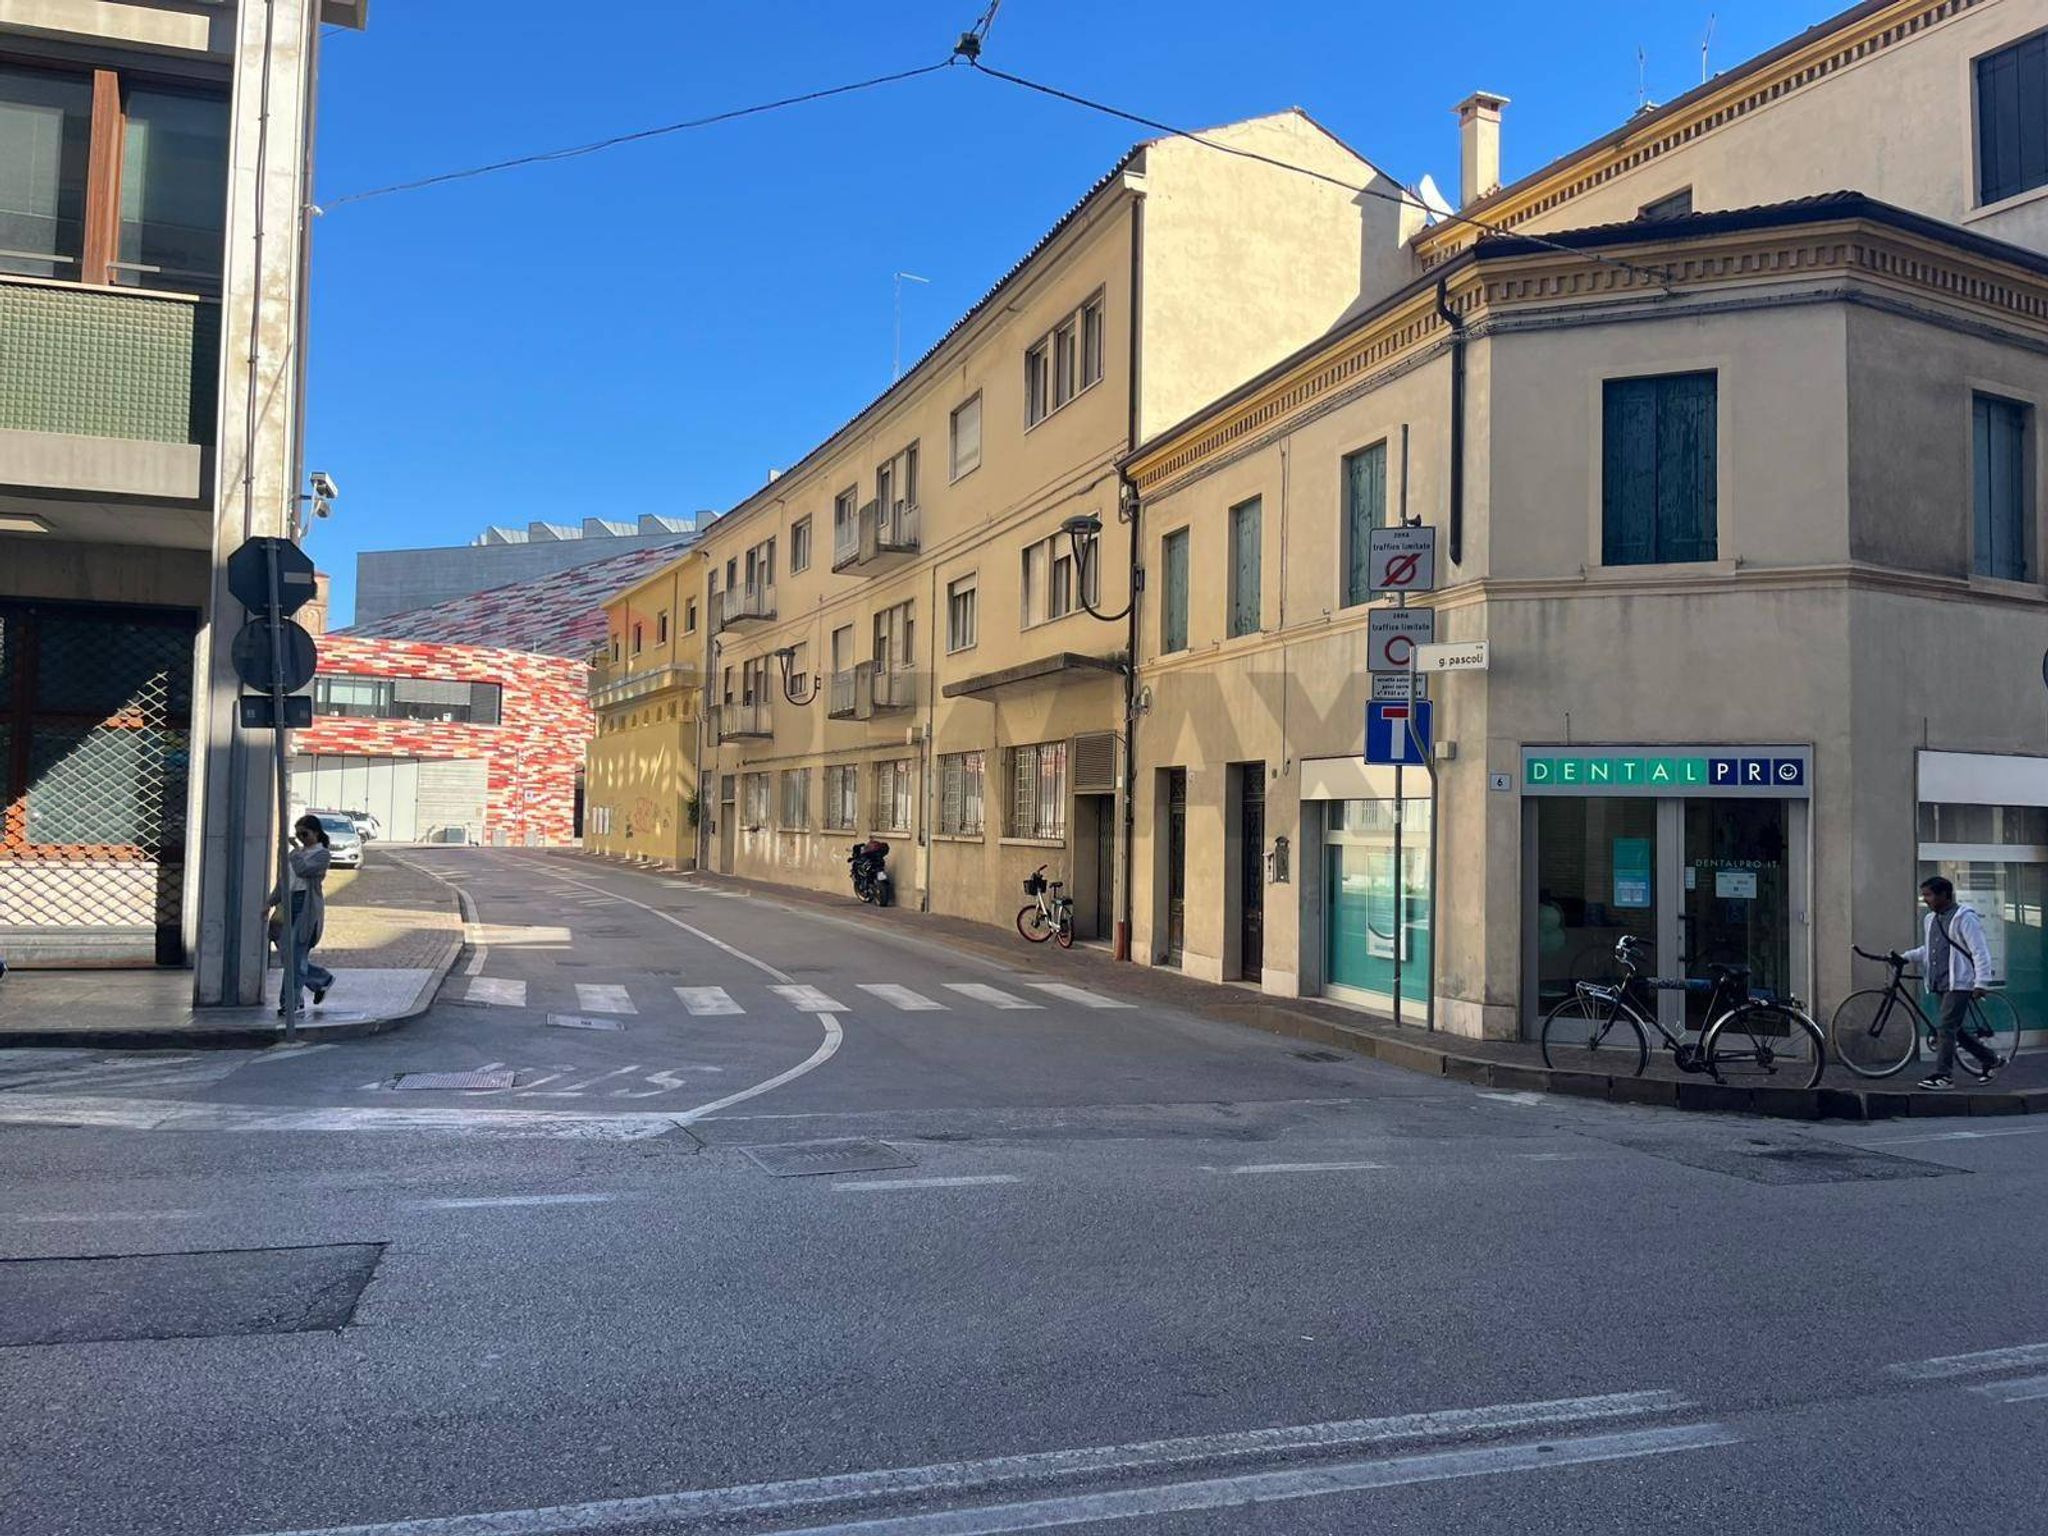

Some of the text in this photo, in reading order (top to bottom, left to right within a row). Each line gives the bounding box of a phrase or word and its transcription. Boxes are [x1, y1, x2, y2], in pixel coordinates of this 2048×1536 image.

[1373, 542, 1430, 551] traffico limitato
[1372, 623, 1430, 631] traffico limitato
[1449, 653, 1484, 667] pascoli
[1496, 777, 1504, 788] 6
